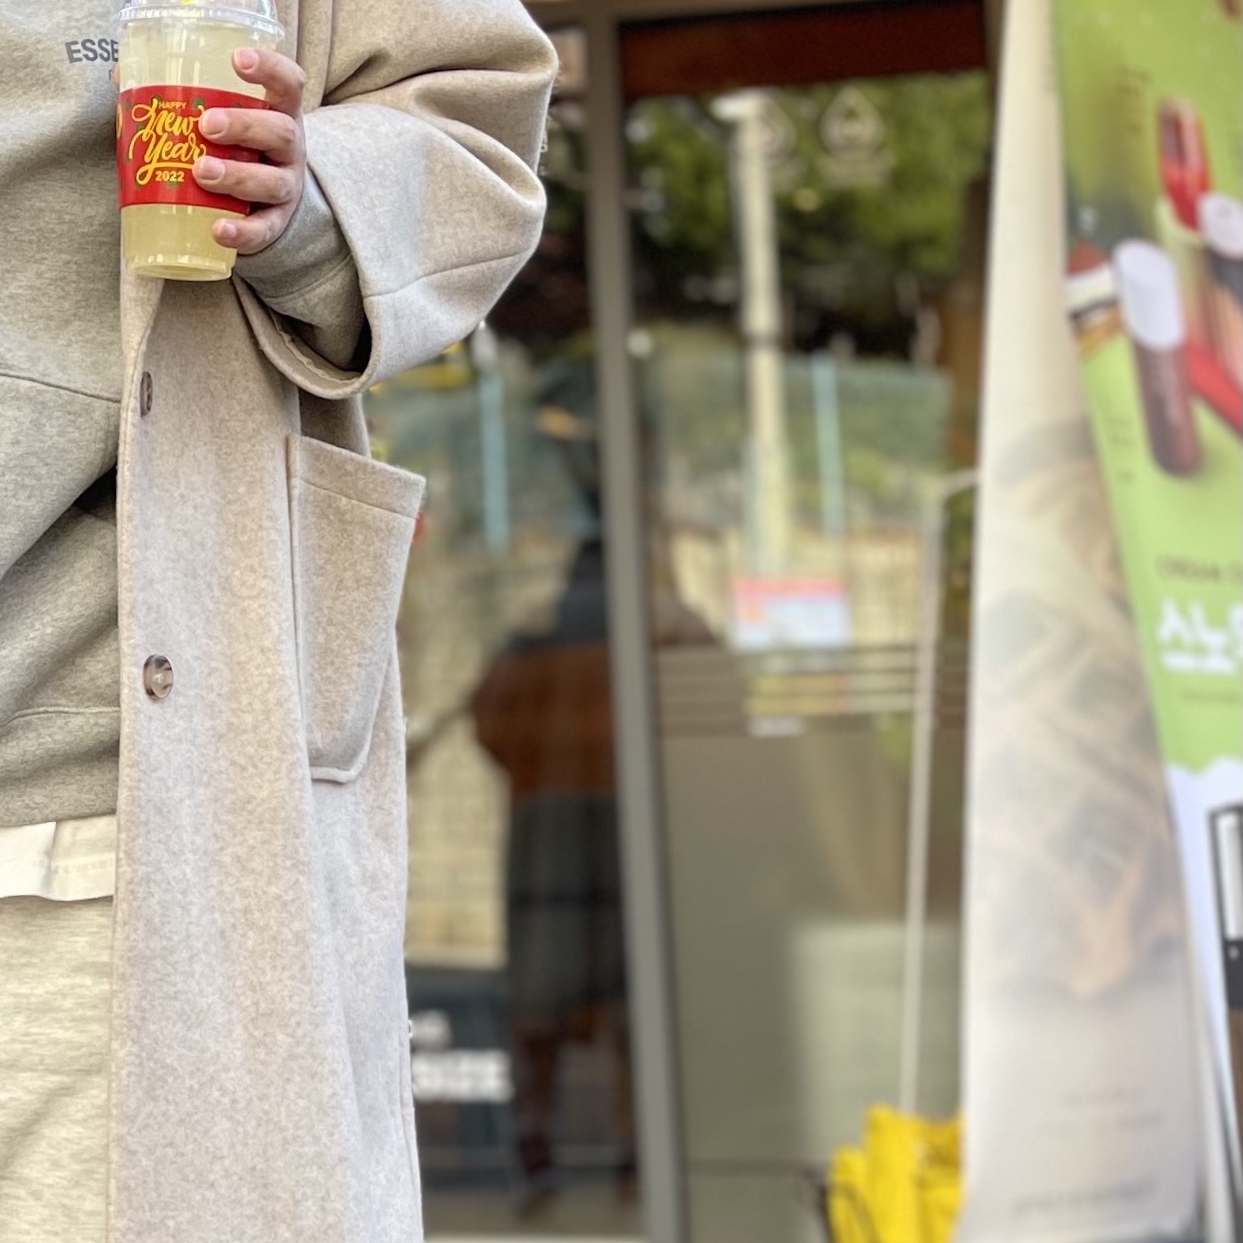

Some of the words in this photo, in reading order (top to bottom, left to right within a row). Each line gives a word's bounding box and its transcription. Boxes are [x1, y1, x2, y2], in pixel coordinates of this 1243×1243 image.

[158, 101, 187, 110] HAPPY
[131, 98, 205, 142] New
[128, 132, 207, 185] Year
[155, 170, 185, 182] 2022
